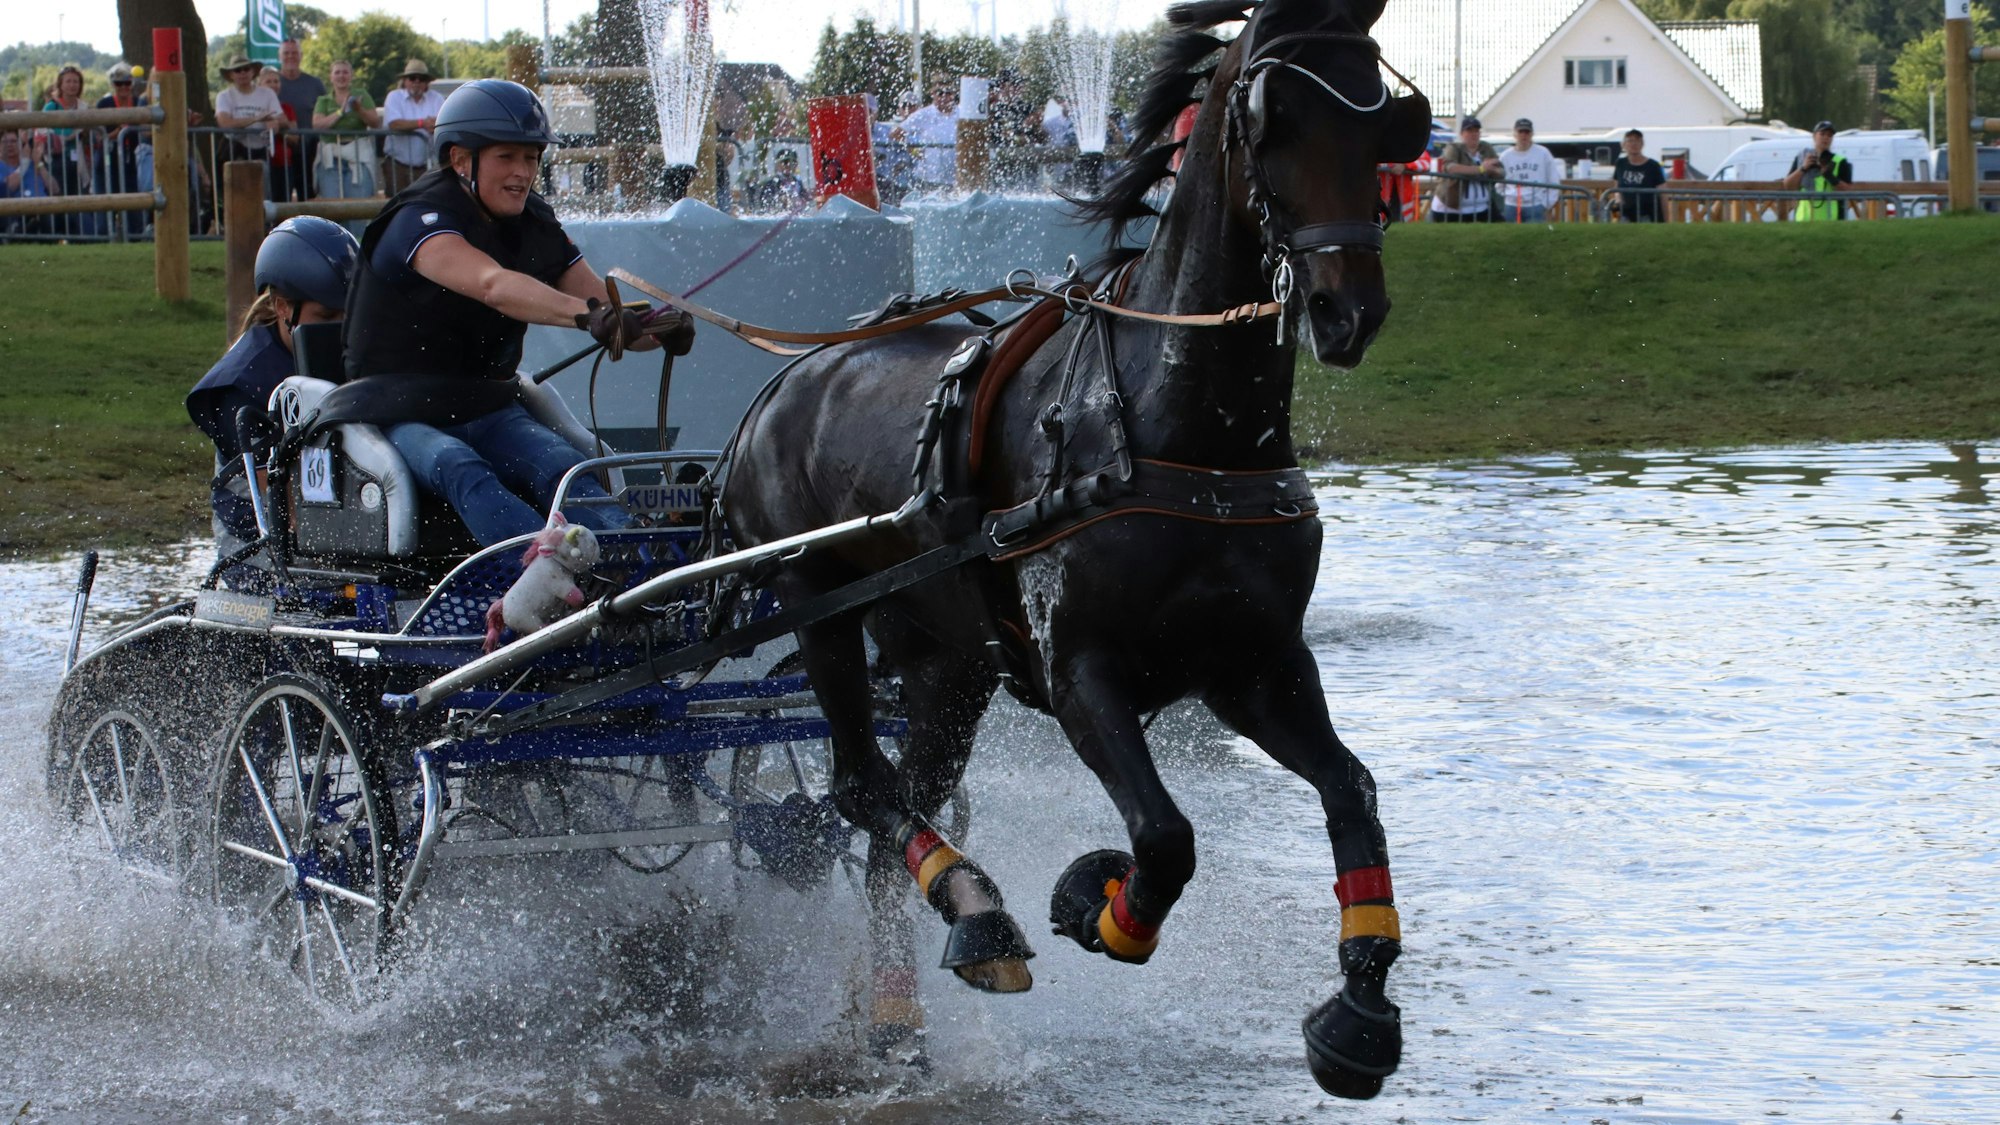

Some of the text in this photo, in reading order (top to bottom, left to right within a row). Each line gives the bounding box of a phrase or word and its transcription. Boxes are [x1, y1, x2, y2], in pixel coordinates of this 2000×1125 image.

[169, 50, 179, 66] d
[821, 151, 842, 184] b
[307, 458, 325, 488] 69
